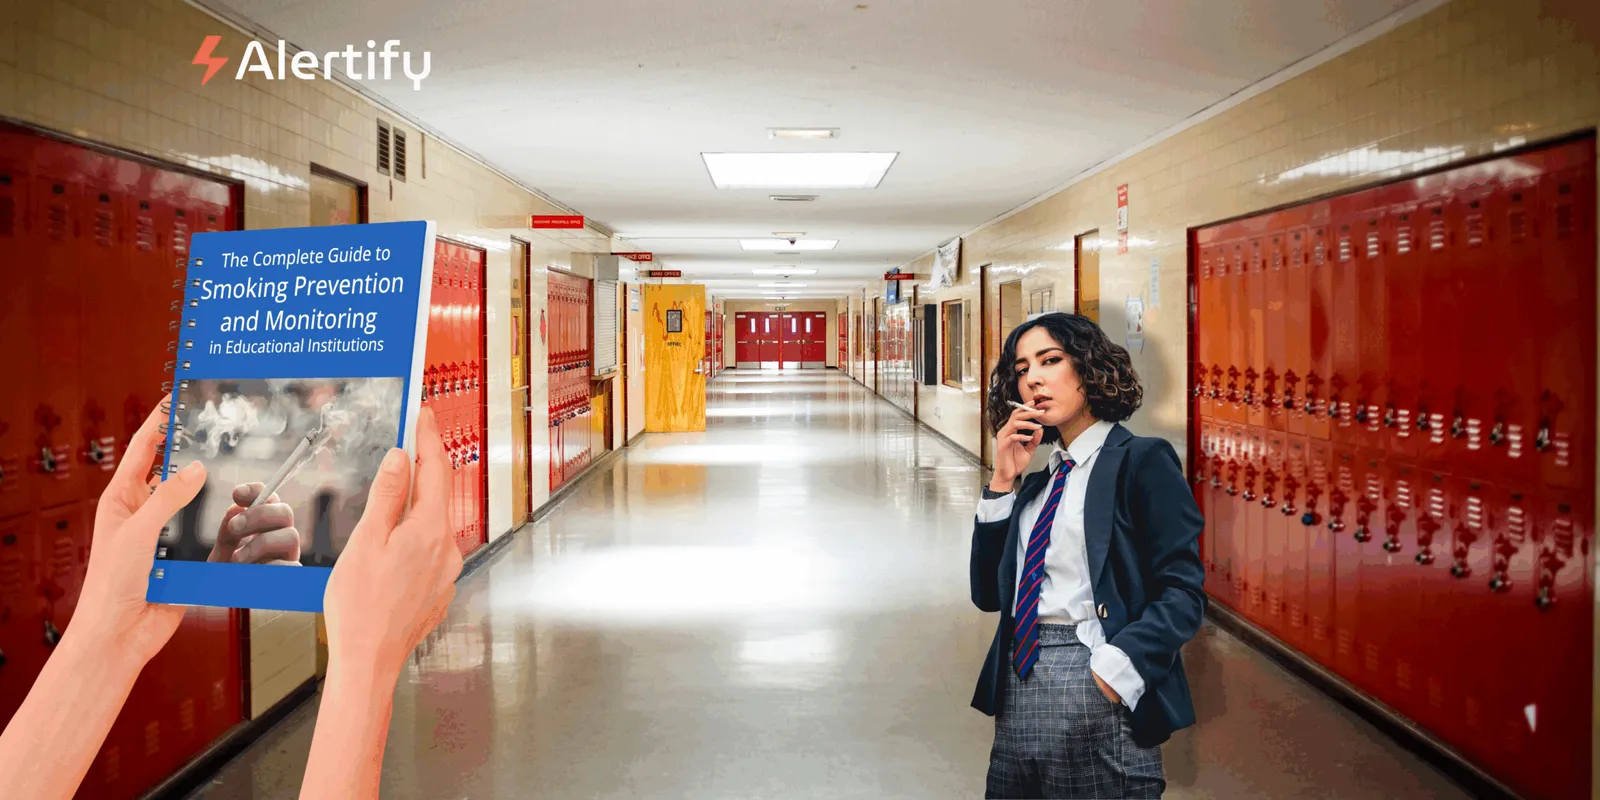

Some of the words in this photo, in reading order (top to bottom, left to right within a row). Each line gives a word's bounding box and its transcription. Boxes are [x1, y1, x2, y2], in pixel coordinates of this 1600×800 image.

[222, 252, 249, 268] The
[253, 249, 324, 270] Complete
[328, 245, 371, 264] Guide
[375, 246, 391, 262] to
[201, 277, 289, 303] Smoking
[294, 272, 405, 298] Prevention
[220, 309, 259, 333] and
[265, 307, 377, 335] Monitoring
[209, 340, 222, 355] in
[226, 338, 304, 355] Educational
[307, 337, 384, 353] Institutions
